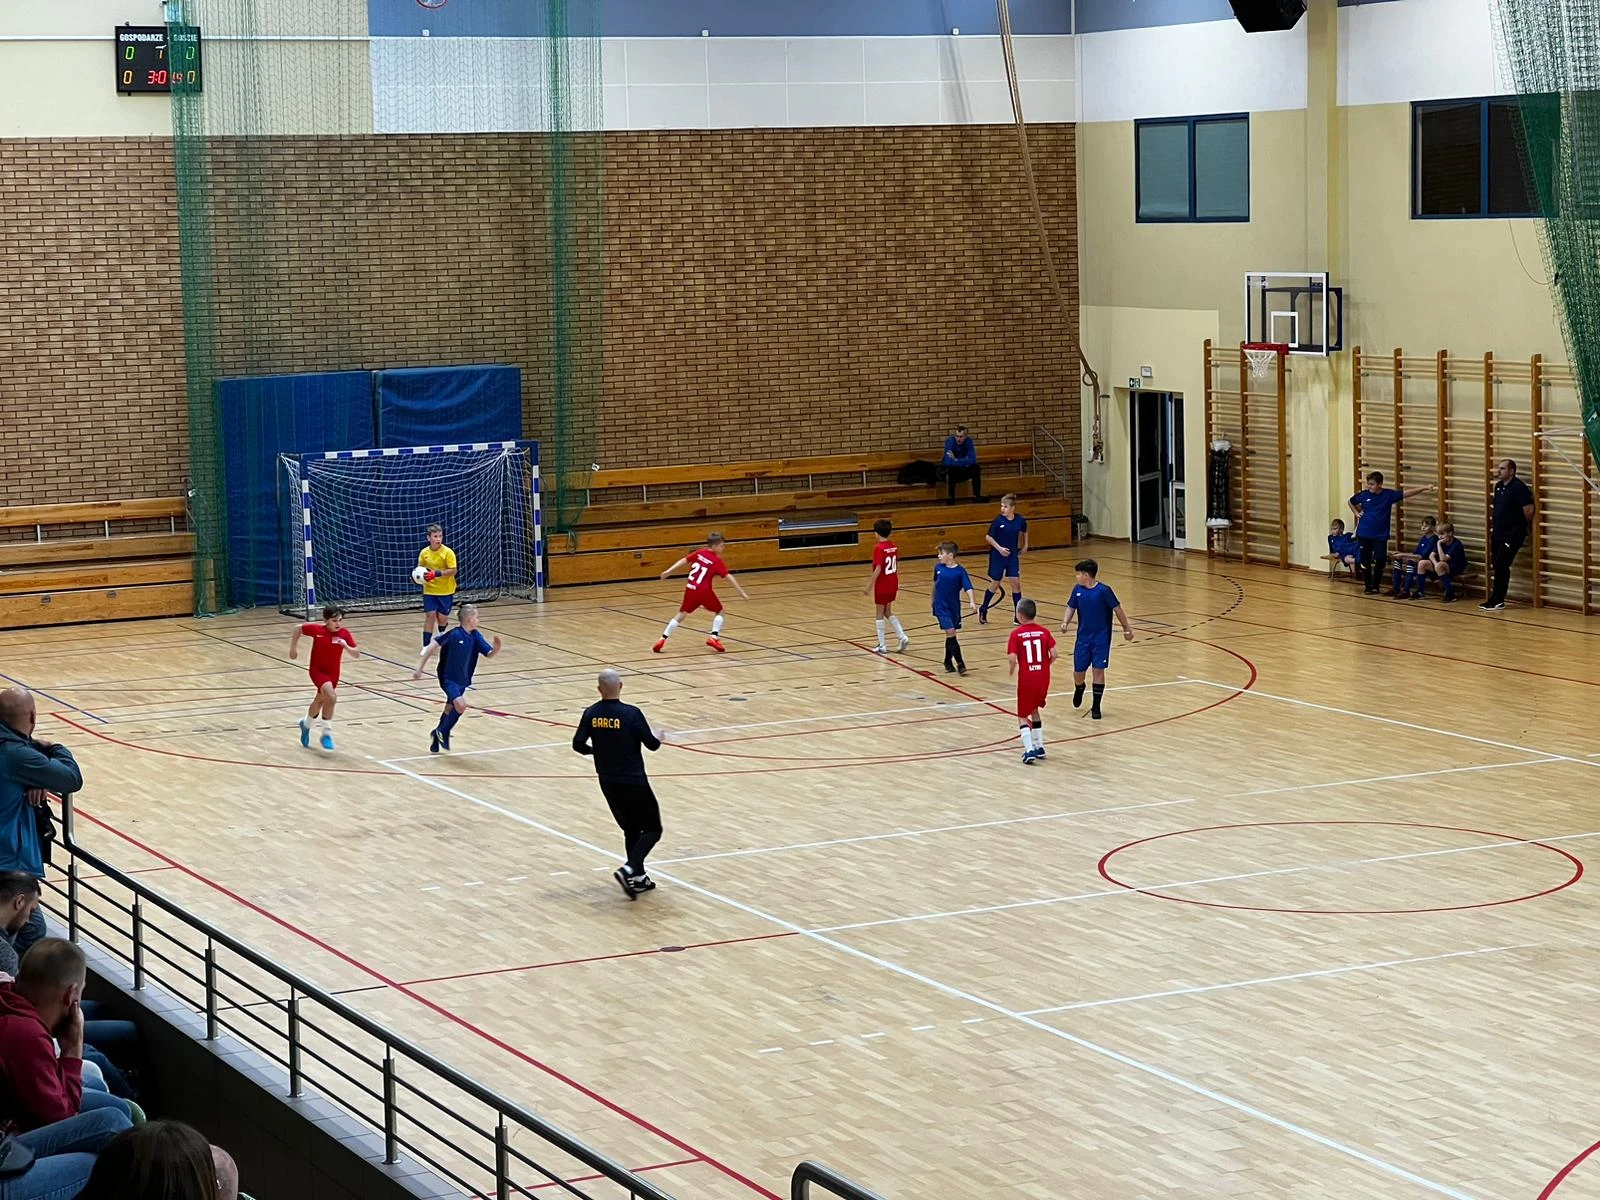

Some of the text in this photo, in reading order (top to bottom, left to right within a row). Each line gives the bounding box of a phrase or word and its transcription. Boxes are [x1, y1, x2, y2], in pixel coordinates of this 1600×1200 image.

[119, 33, 164, 42] GOSPODARZE
[125, 46, 135, 60] 0
[123, 70, 133, 84] 0
[1022, 639, 1042, 664] 11
[591, 717, 621, 729] BARCA
